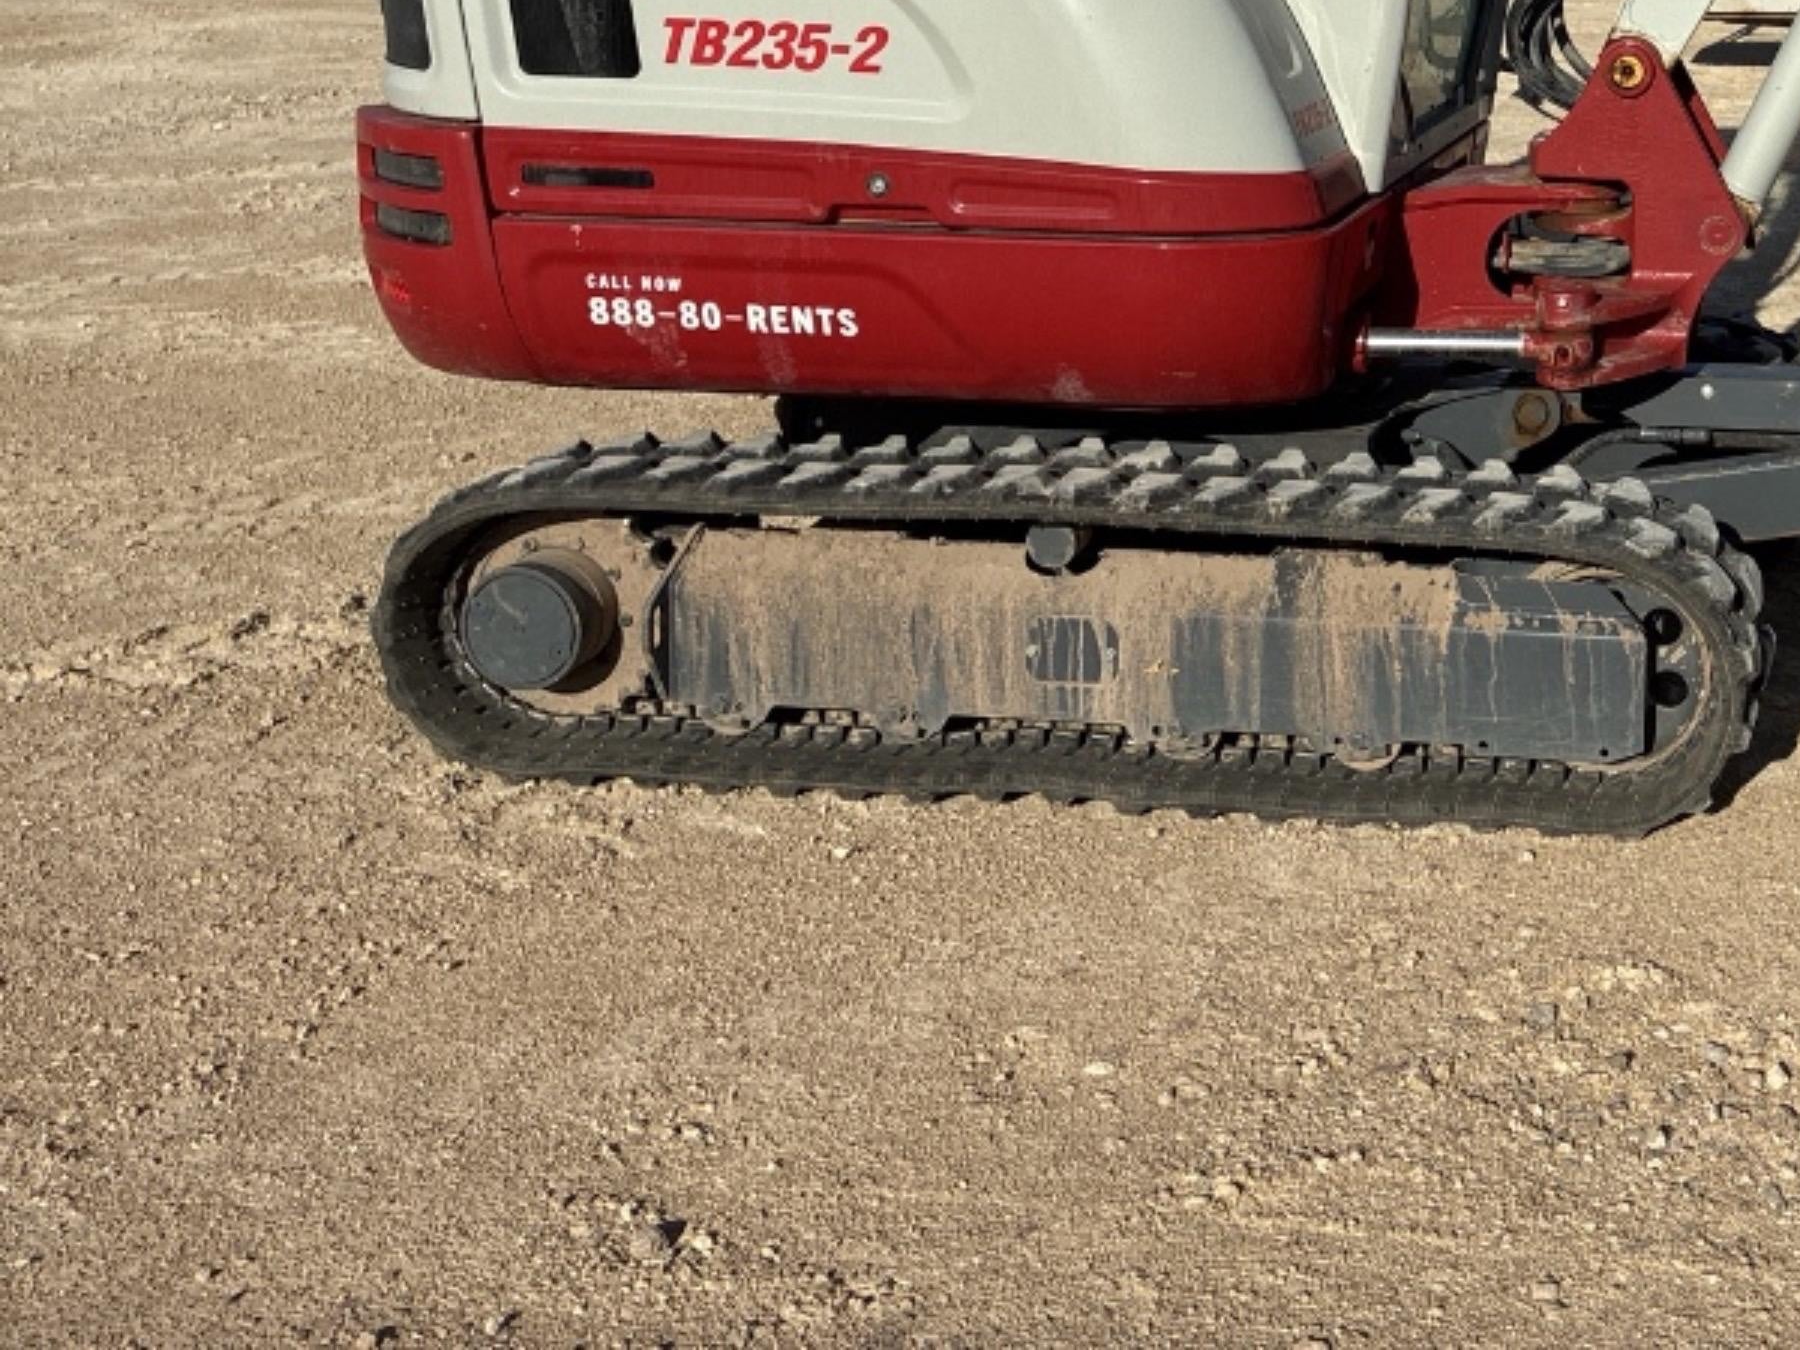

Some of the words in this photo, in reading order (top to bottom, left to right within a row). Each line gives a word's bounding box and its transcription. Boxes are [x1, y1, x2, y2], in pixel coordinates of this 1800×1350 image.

[663, 17, 890, 73] TB235-2
[585, 273, 633, 290] CALL
[640, 275, 682, 293] NOW
[588, 296, 859, 337] 888-80-RENTS
